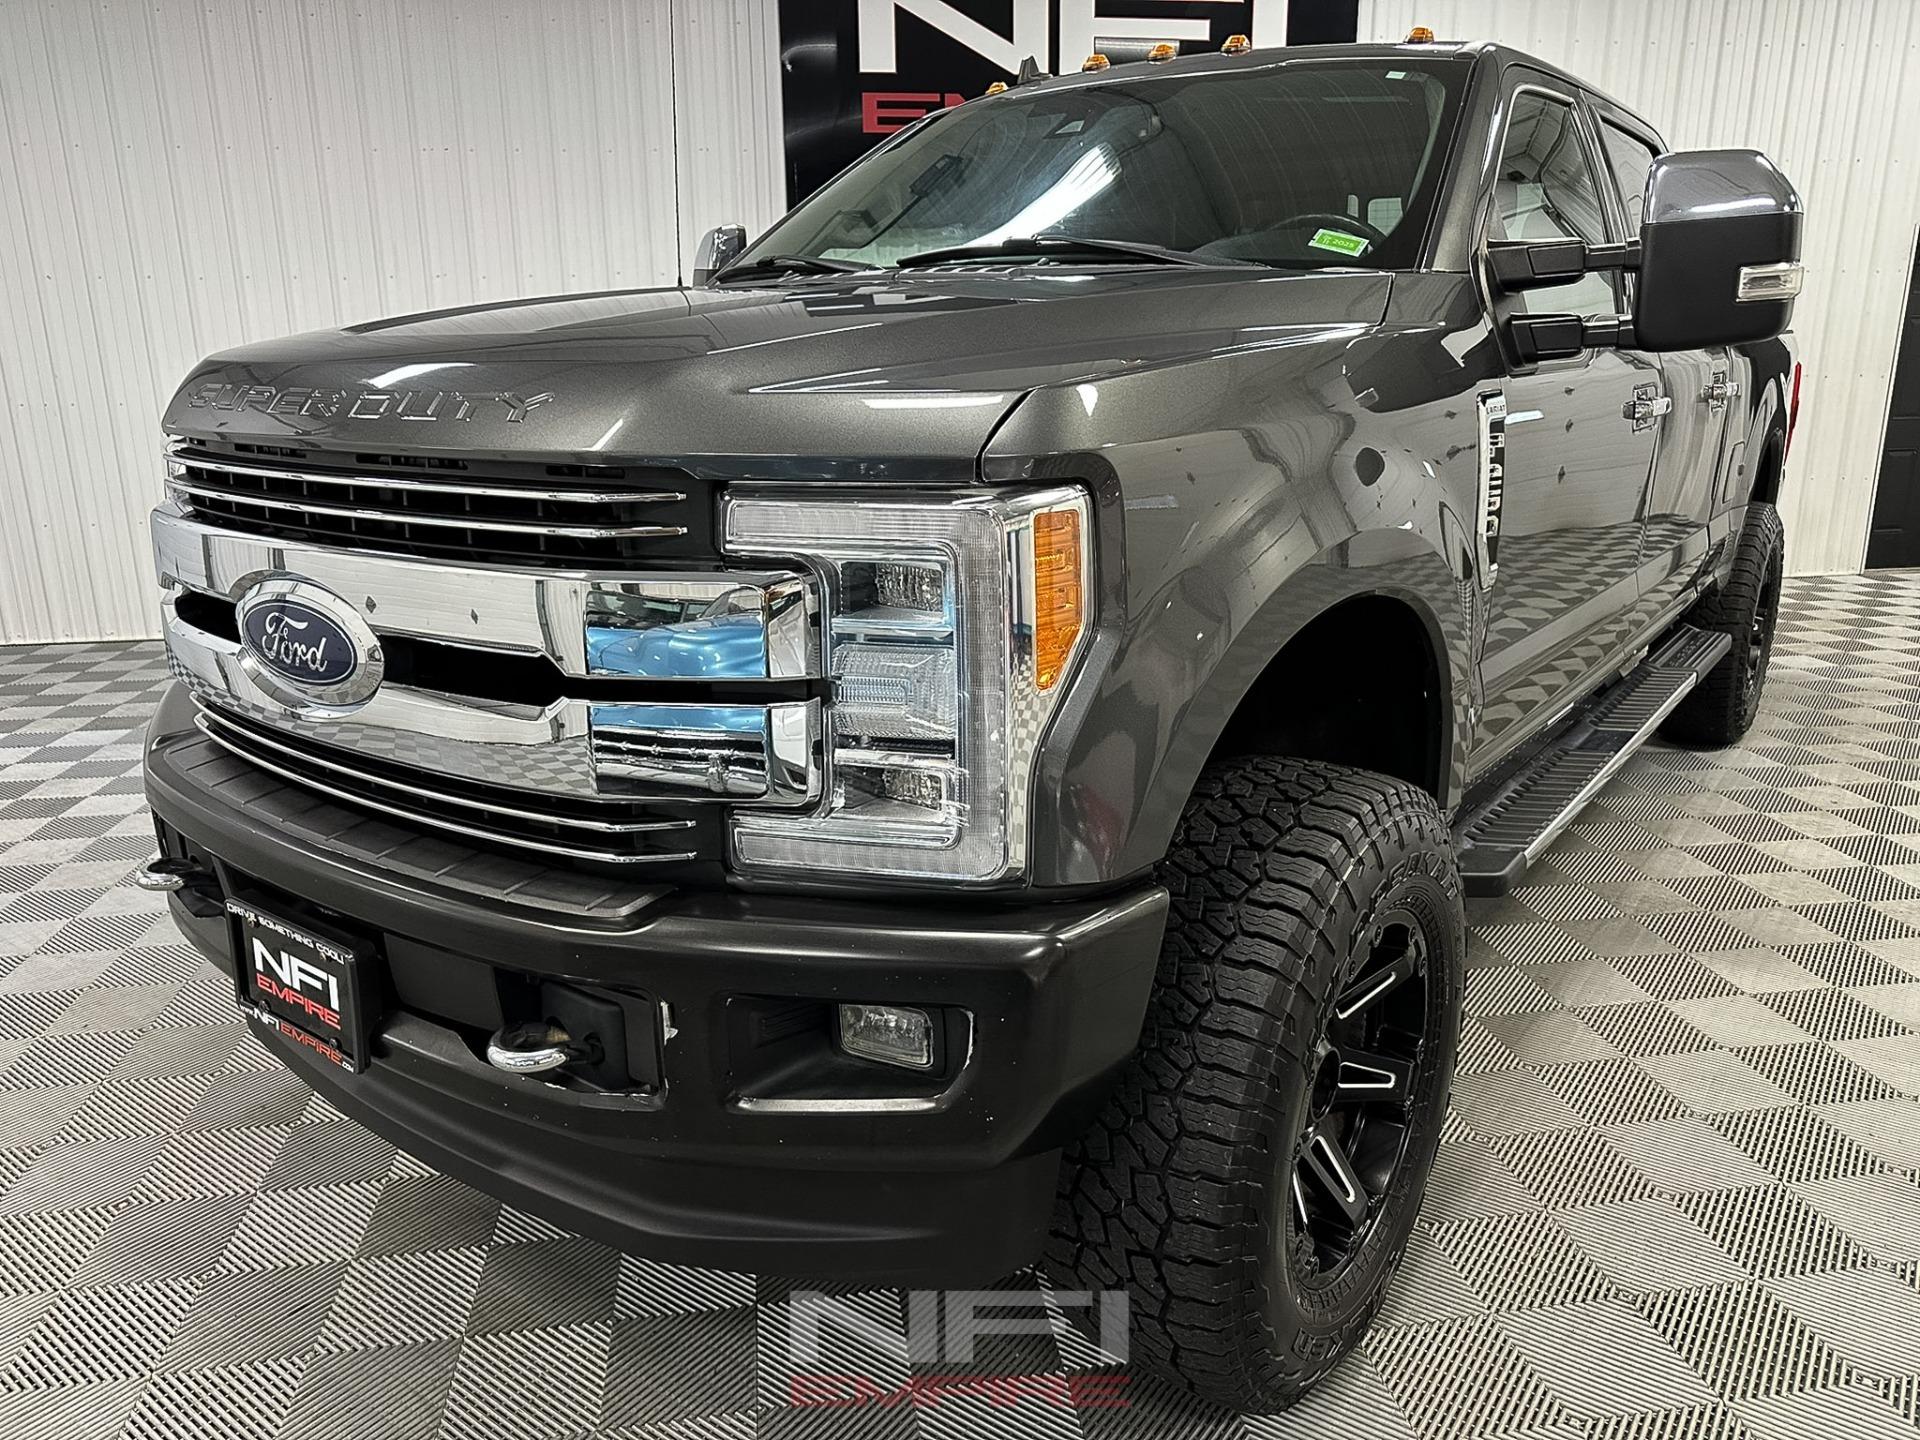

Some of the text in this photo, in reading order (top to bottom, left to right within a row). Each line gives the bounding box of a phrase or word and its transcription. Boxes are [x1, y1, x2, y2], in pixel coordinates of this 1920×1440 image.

[188, 383, 555, 423] SUPER DUTY
[262, 612, 328, 672] Ford
[226, 902, 257, 922] DRIVE
[258, 916, 315, 949] SOMETHING
[252, 937, 340, 1012] NFI
[256, 973, 341, 1031] EMPIRE
